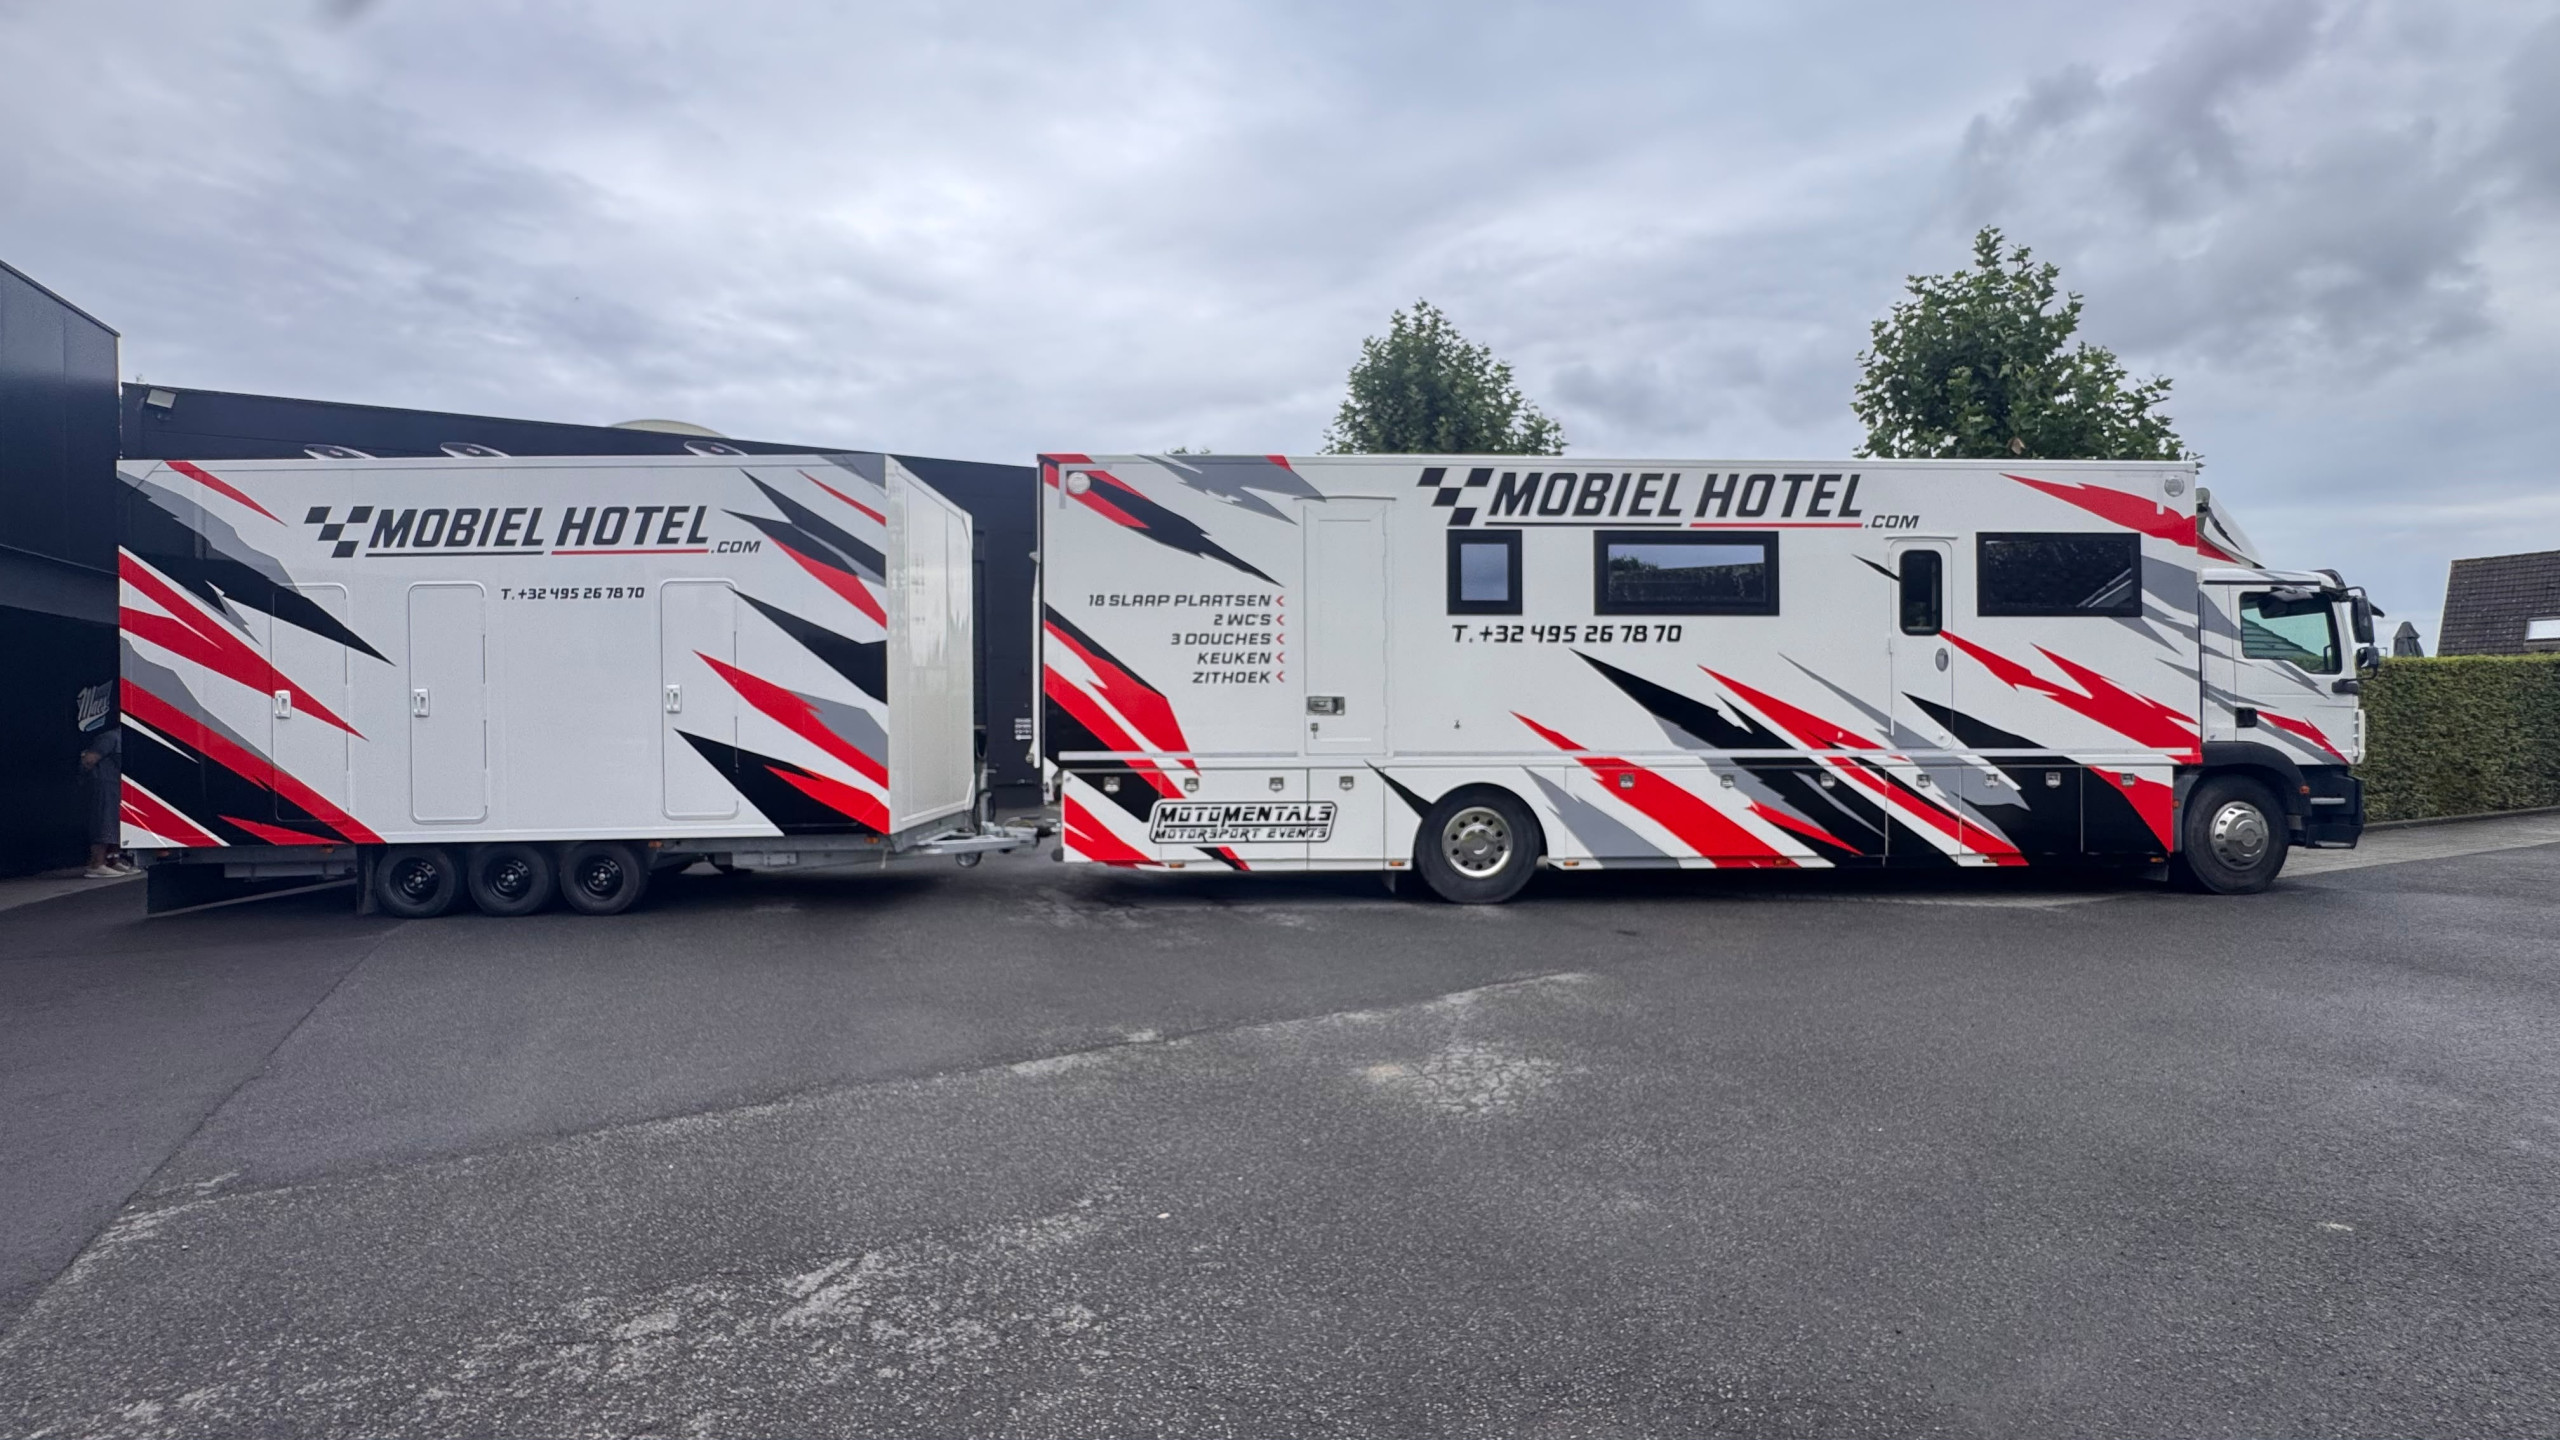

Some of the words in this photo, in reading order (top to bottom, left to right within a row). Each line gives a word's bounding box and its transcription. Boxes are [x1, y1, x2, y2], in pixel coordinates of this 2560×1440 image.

[1487, 472, 1682, 517] MOBIEL
[1694, 473, 1863, 518] HOTEL
[1864, 514, 1920, 529] .COM
[368, 507, 544, 549] MOBIEL
[555, 505, 709, 547] HOTEL
[710, 540, 762, 554] .COM
[550, 587, 580, 600] 495
[583, 587, 603, 599] 26
[606, 587, 624, 599] 78
[627, 586, 645, 599] 70
[1089, 594, 1105, 607] 18
[1108, 594, 1171, 607] SLAAP
[1173, 594, 1272, 607] PLAATSEN
[1213, 613, 1224, 626] 2
[1170, 632, 1181, 646] 3
[1184, 632, 1272, 646] DOUCHES
[1530, 625, 1578, 644] 495
[1584, 625, 1614, 643] 26
[1620, 624, 1648, 643] 78
[1653, 624, 1683, 643] 70
[1197, 652, 1272, 665] KEUKEN
[1192, 671, 1271, 684] ZITHOEK
[1157, 805, 1333, 827] MOTOMENTALS
[1154, 828, 1261, 841] MOTORSPORT
[1267, 827, 1328, 839] EVENTS
